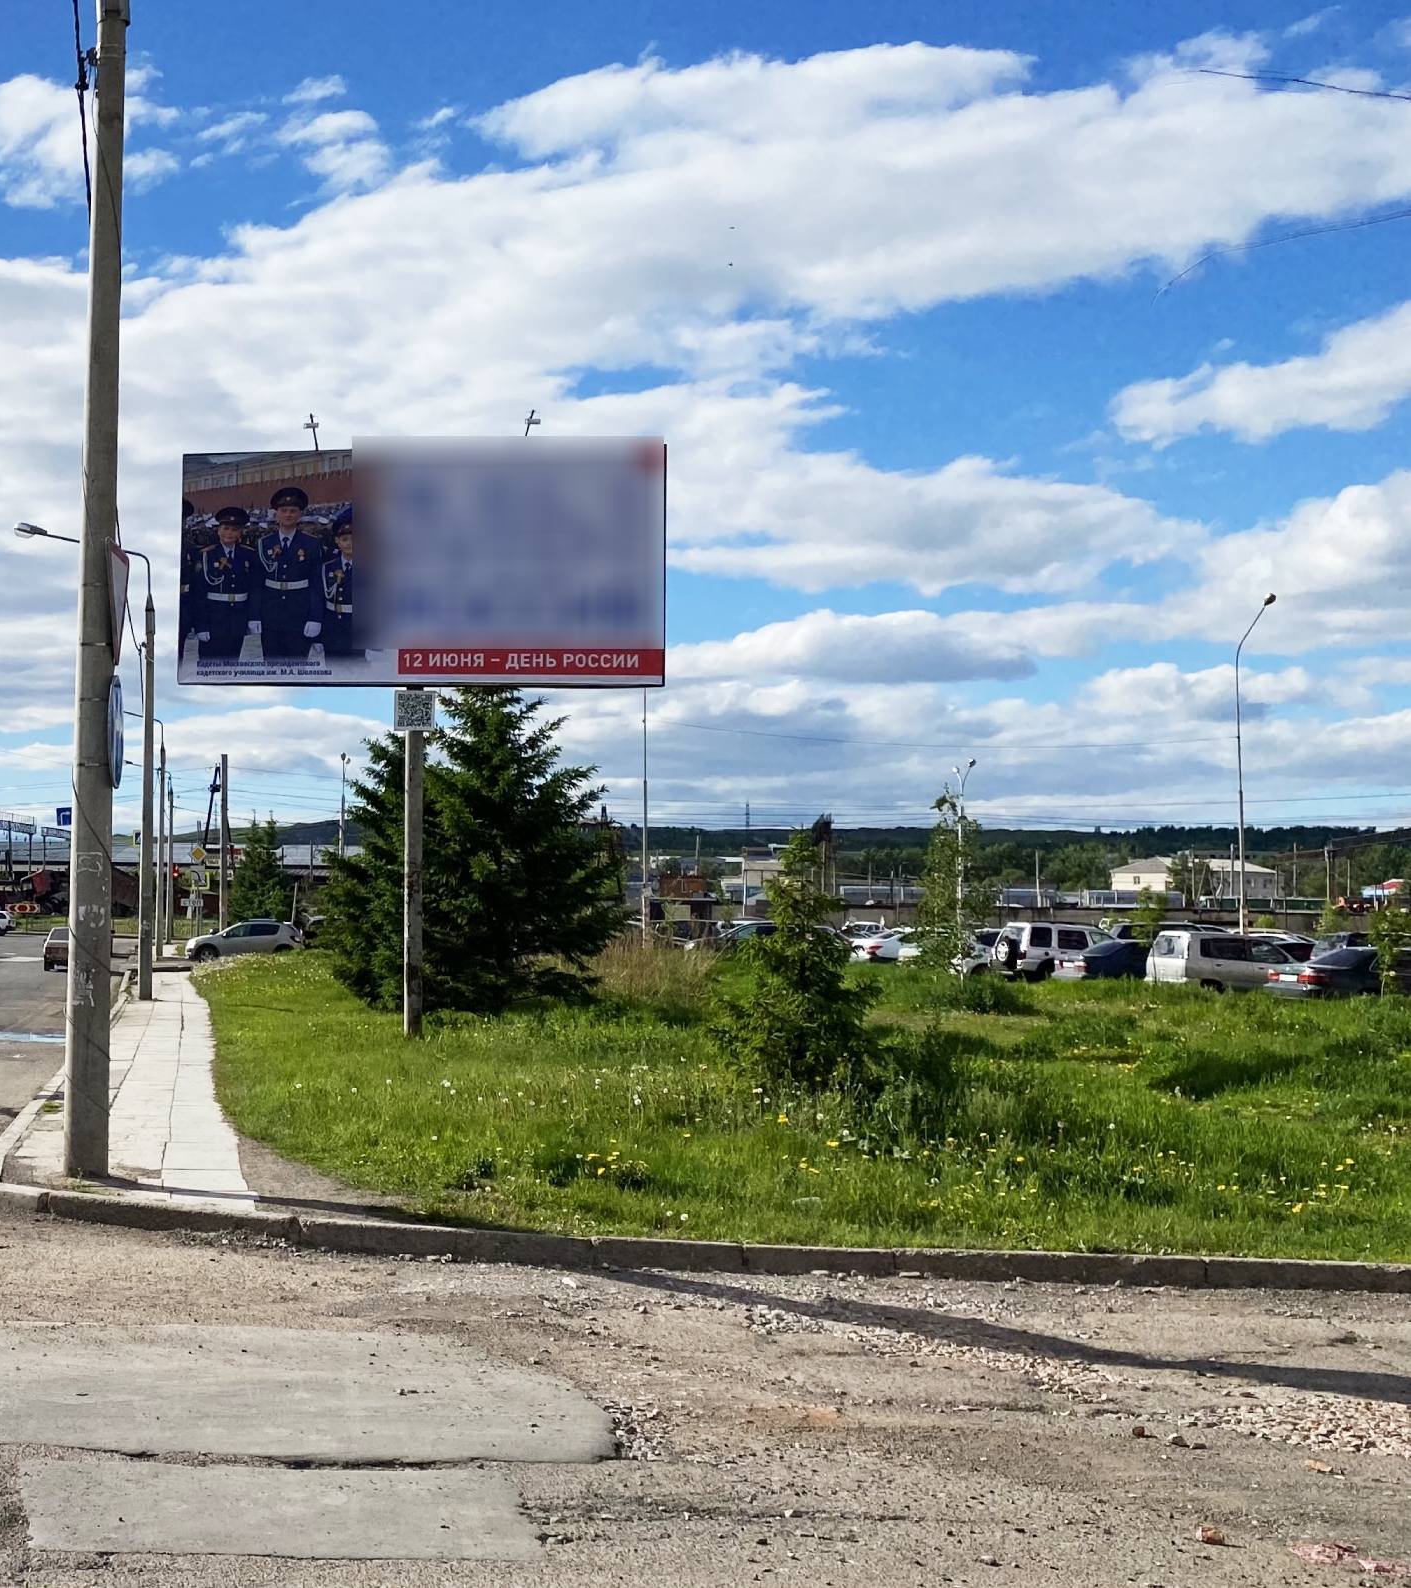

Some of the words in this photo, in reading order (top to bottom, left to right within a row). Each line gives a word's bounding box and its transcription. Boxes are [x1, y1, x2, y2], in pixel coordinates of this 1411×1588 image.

[403, 653, 423, 668] 12
[428, 653, 485, 668] ИЮНЯ
[505, 653, 557, 670] ДЕНЬ
[563, 653, 639, 669] РОССИИ
